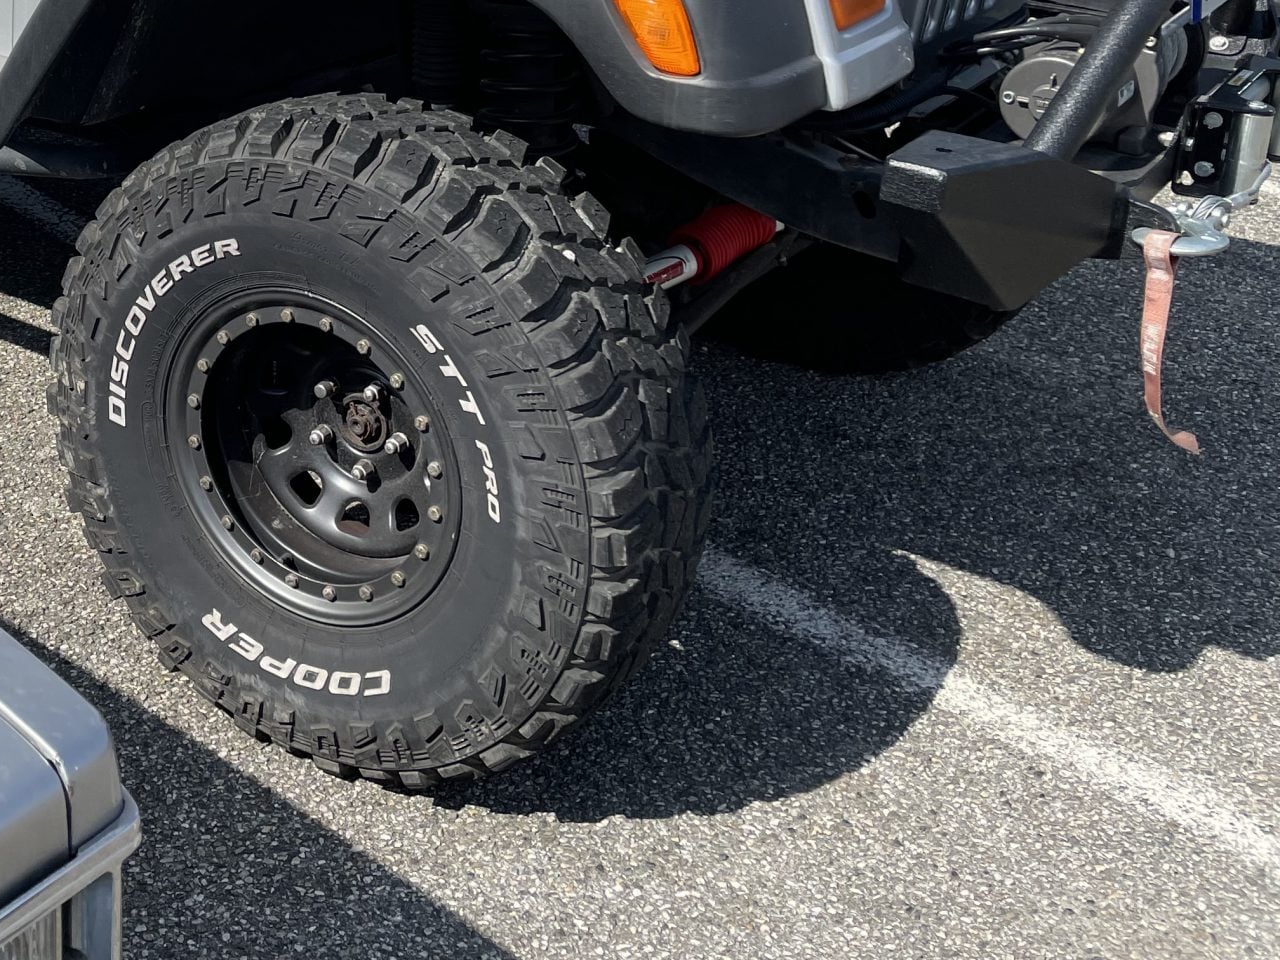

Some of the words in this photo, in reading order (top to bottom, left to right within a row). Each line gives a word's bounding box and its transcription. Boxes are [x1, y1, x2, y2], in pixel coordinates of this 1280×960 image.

[108, 237, 241, 427] DISCOVERER
[410, 324, 486, 426] STT
[475, 440, 502, 523] PRO
[201, 608, 392, 698] COOPER
